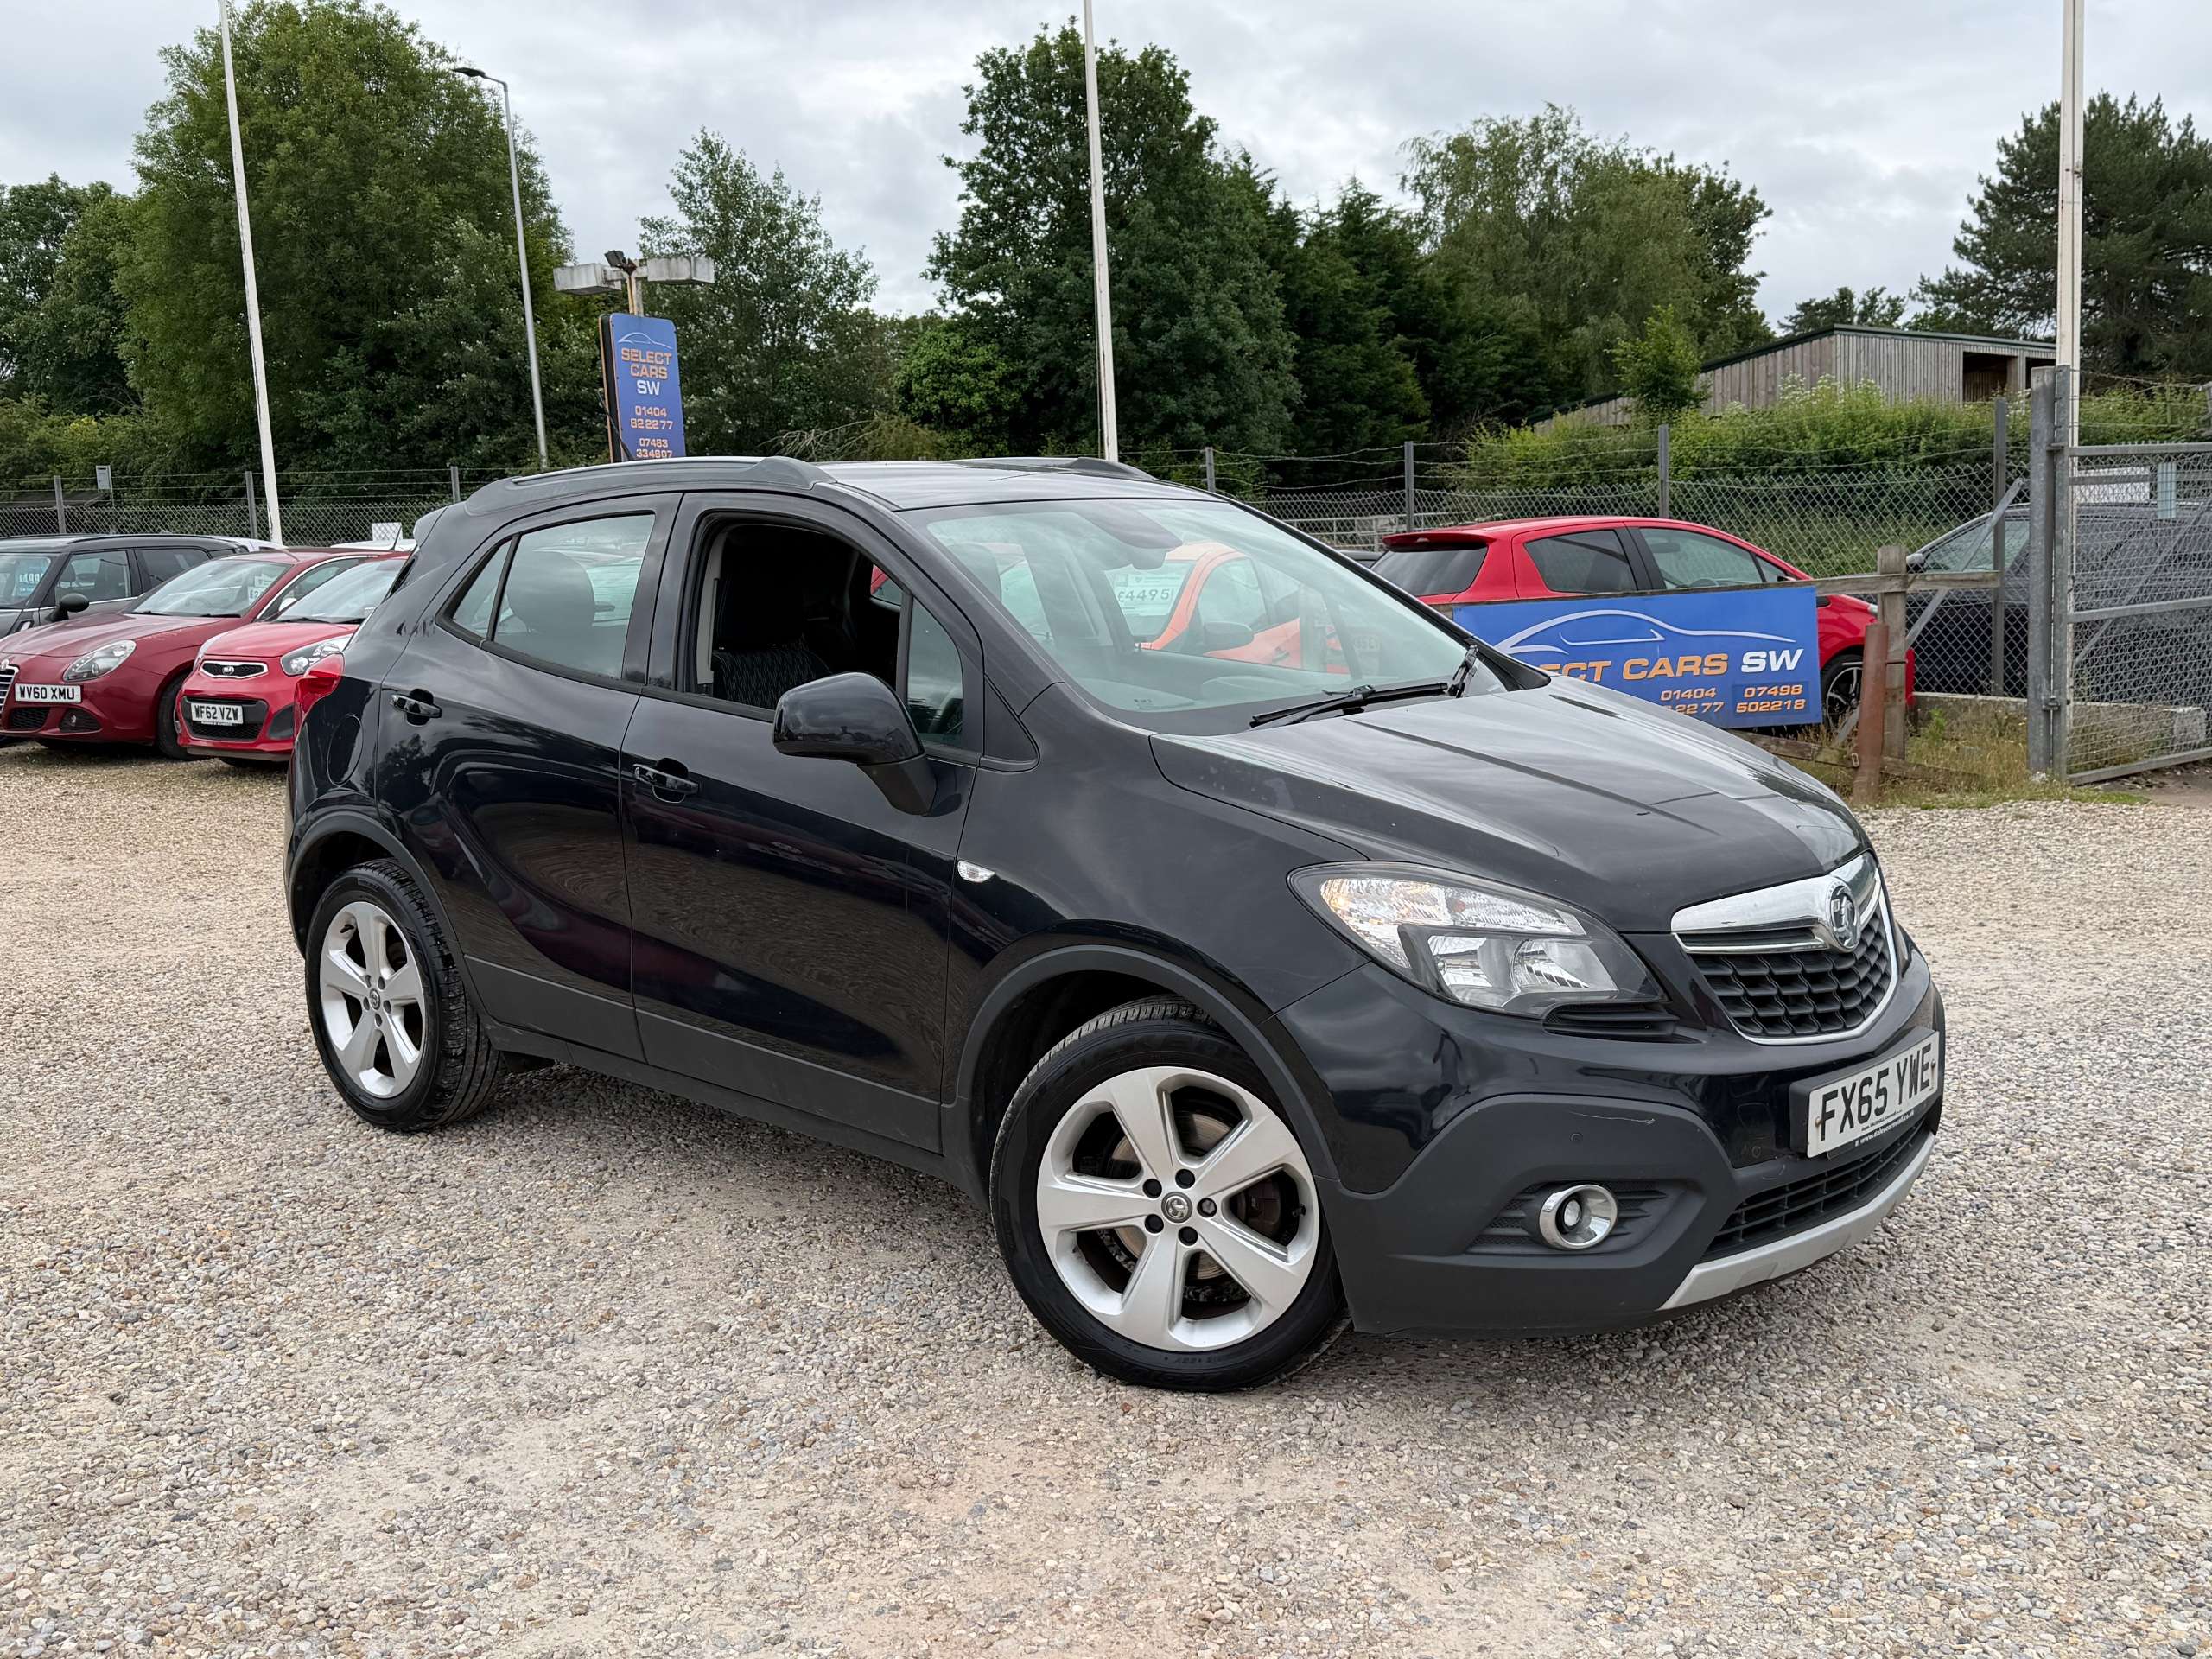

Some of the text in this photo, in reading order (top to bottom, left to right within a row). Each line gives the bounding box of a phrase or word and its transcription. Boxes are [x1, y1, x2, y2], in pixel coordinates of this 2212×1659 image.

[621, 348, 672, 365] SELECT
[631, 365, 668, 380] CARS
[637, 380, 660, 395] SW
[635, 406, 667, 417] 01404
[1118, 588, 1170, 603] £4495
[1622, 653, 1728, 680] CARS
[1741, 648, 1804, 673] SW
[19, 685, 75, 700] WV60 XMU
[1660, 687, 1717, 701] 01404
[1744, 684, 1803, 698] 07498
[194, 705, 238, 721] WF62 VZW
[1736, 699, 1806, 713] 502218
[1820, 1043, 1932, 1141] FX65 YWE
